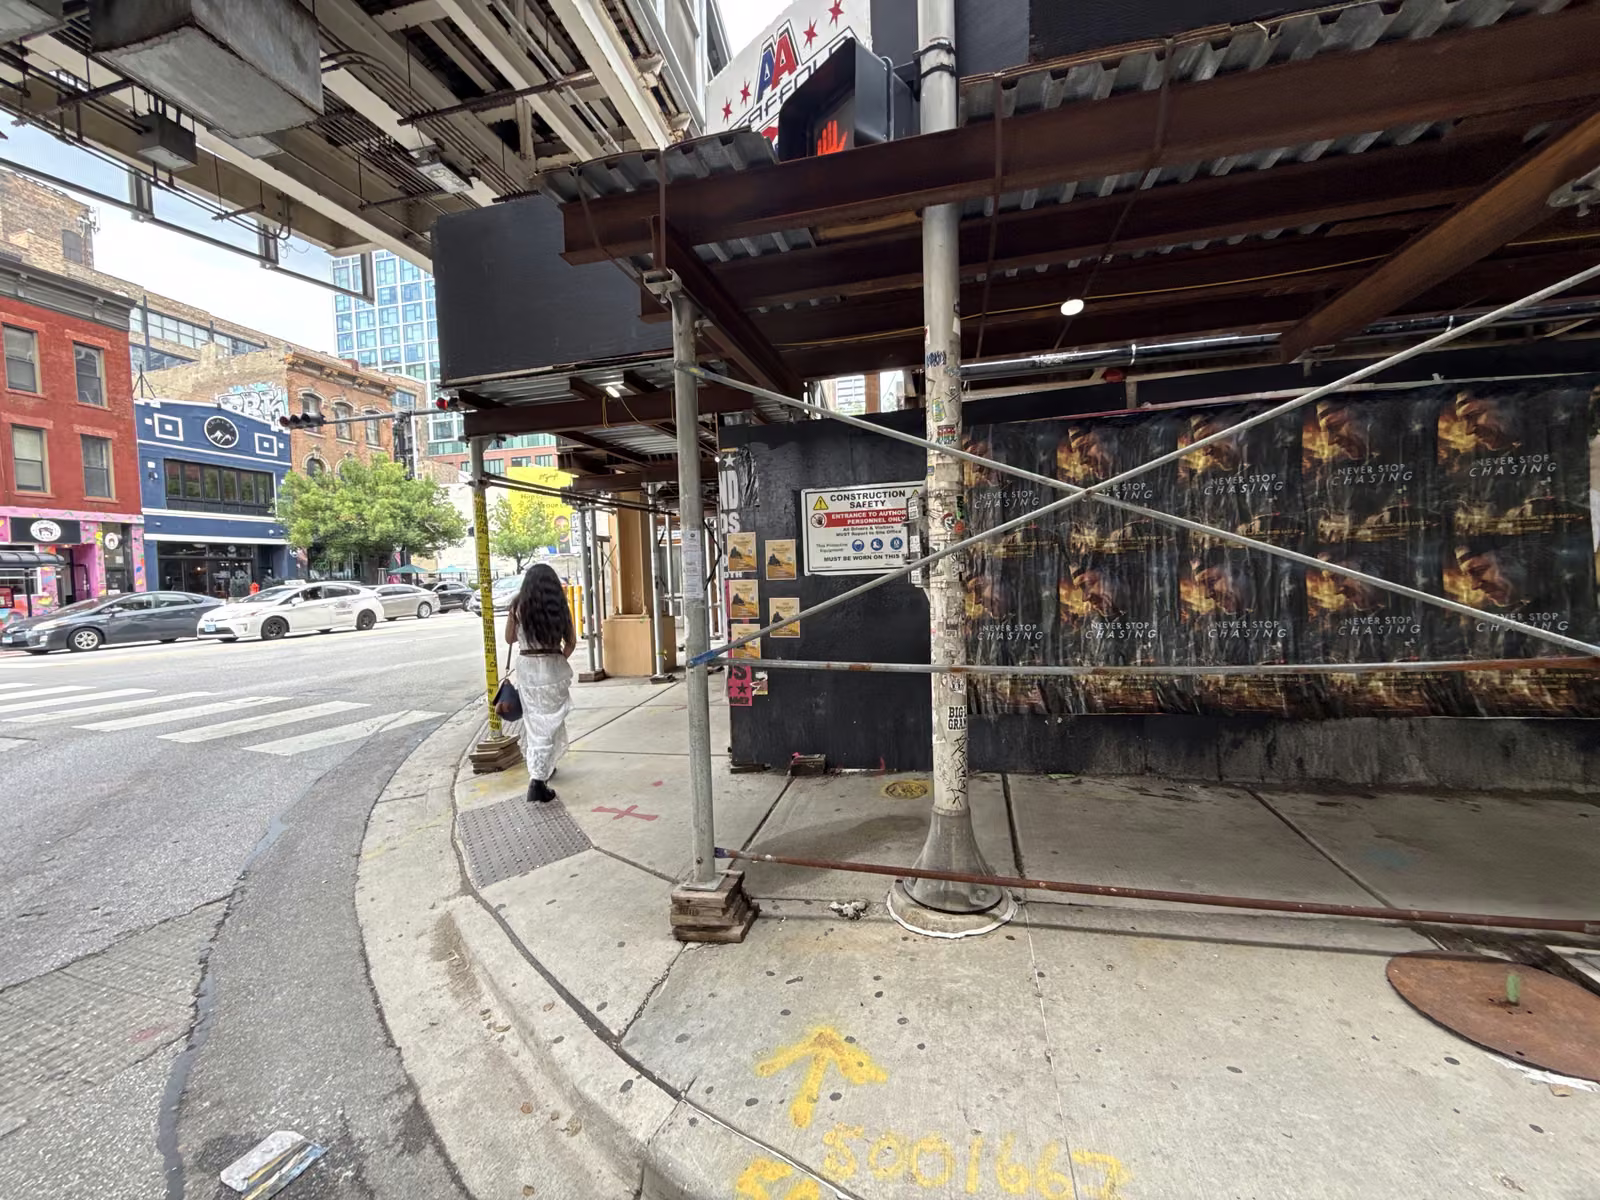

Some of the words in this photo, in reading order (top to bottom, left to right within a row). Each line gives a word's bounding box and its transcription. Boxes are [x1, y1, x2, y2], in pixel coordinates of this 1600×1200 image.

[1475, 456, 1514, 466] NEVER
[1520, 454, 1549, 464] STOP
[1338, 466, 1372, 475] NEVER
[1378, 464, 1405, 472] STOP
[1469, 463, 1557, 477] CHASING
[1211, 477, 1244, 485] NEVER
[1249, 474, 1276, 482] STOP
[1331, 471, 1413, 485] CHASING
[1121, 483, 1146, 491] STOP
[1204, 482, 1284, 495] CHASING
[830, 490, 905, 502] CONSTRUCTION
[980, 491, 1007, 499] NEVER
[850, 500, 886, 509] SAFETY
[974, 498, 1039, 509] CHASING
[832, 511, 866, 519] ENTRANCE
[1345, 617, 1380, 625] NEVER
[1385, 616, 1411, 625] STOP
[982, 624, 1011, 632] NEVER
[1091, 622, 1122, 630] NEVER
[1338, 624, 1421, 635] CHASING
[978, 631, 1043, 640] CHASING
[1085, 629, 1157, 639] CHASING
[1208, 628, 1287, 638] CHASING
